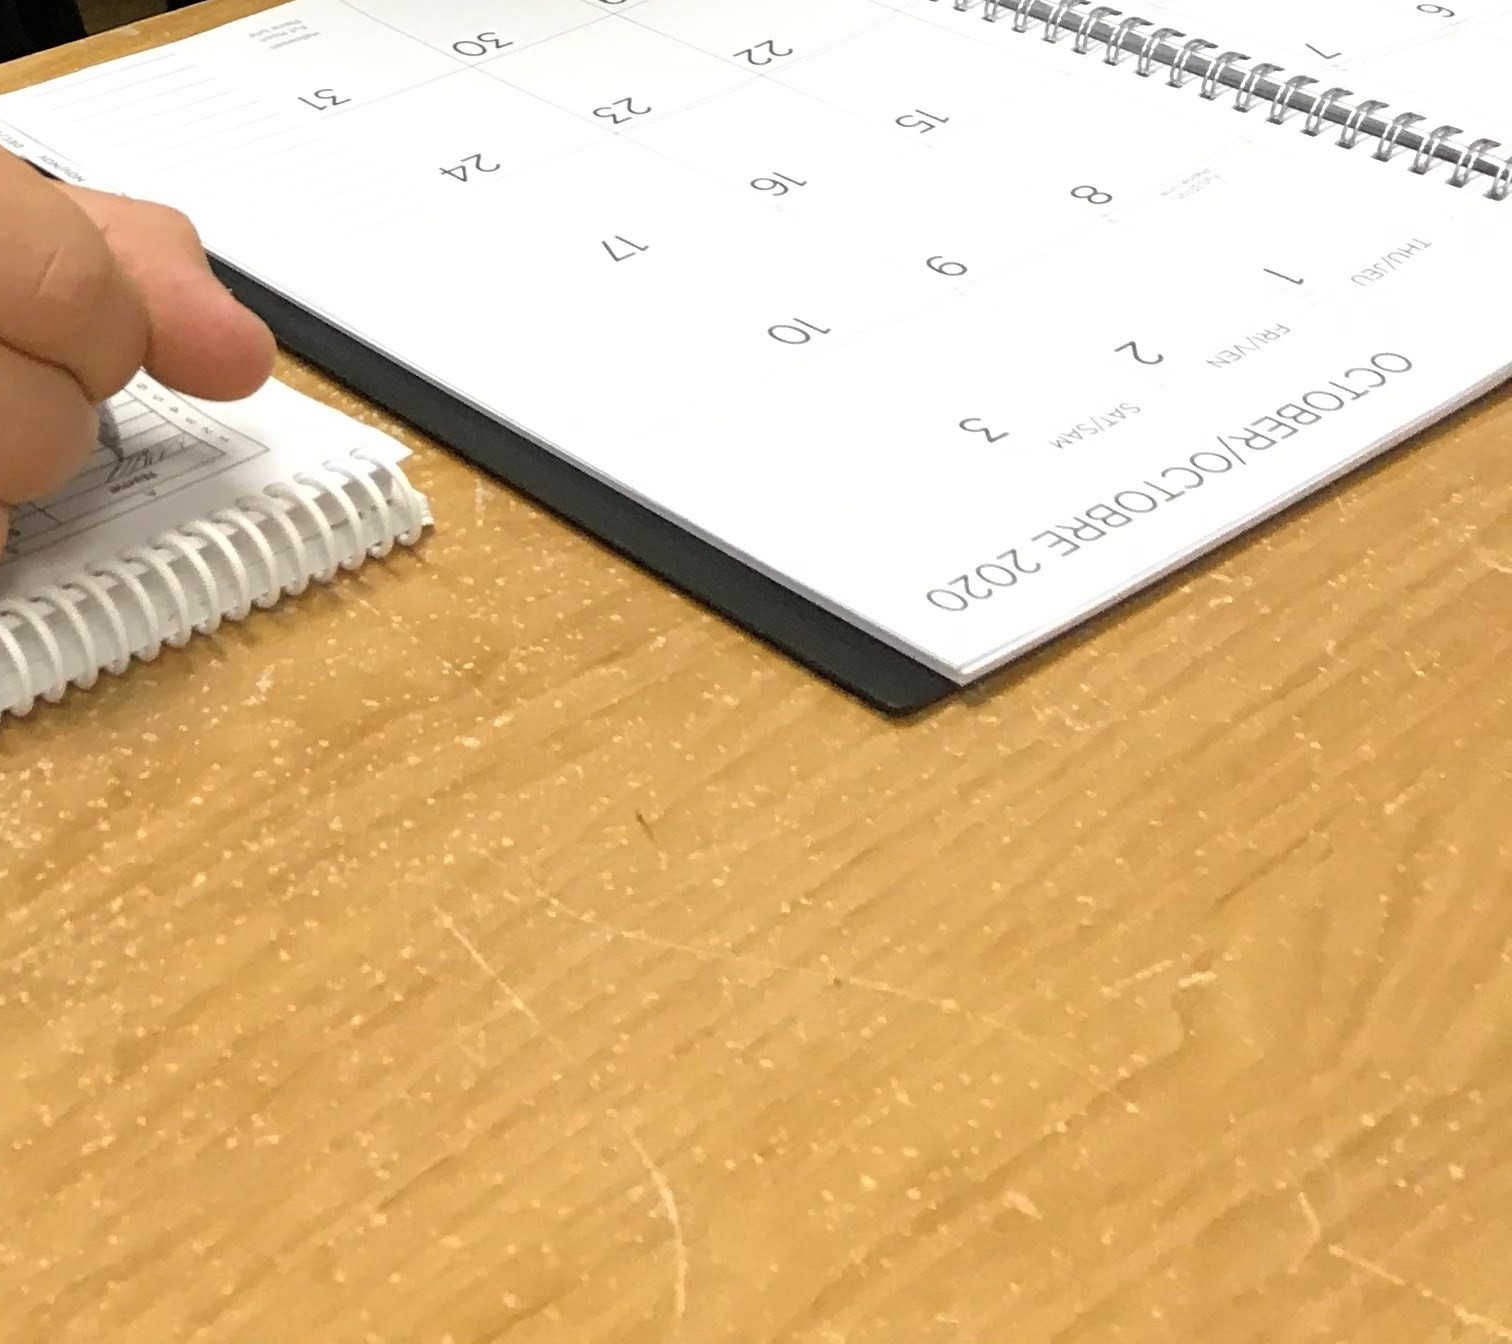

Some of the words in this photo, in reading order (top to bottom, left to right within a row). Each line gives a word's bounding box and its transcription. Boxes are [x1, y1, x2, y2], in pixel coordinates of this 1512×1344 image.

[452, 31, 514, 57] 30
[733, 40, 794, 66] 22
[1304, 43, 1342, 60] 7
[298, 88, 351, 111] 31
[592, 97, 652, 124] 23
[895, 109, 949, 134] 15
[439, 153, 501, 182] 24
[750, 171, 808, 196] 16
[1070, 185, 1113, 205] 8
[601, 235, 649, 262] 17
[926, 255, 968, 277] 9
[1351, 237, 1432, 288] THU/JEU
[1263, 268, 1304, 285] 1
[767, 318, 831, 345] 10
[1114, 340, 1164, 366] 2
[1206, 322, 1291, 369] FRI/VEN
[958, 417, 1009, 443] 3
[1048, 401, 1142, 450] SAT/SAM
[1030, 352, 1412, 557] OCTOBER/OCTOBRE
[926, 548, 1041, 611] 2020
